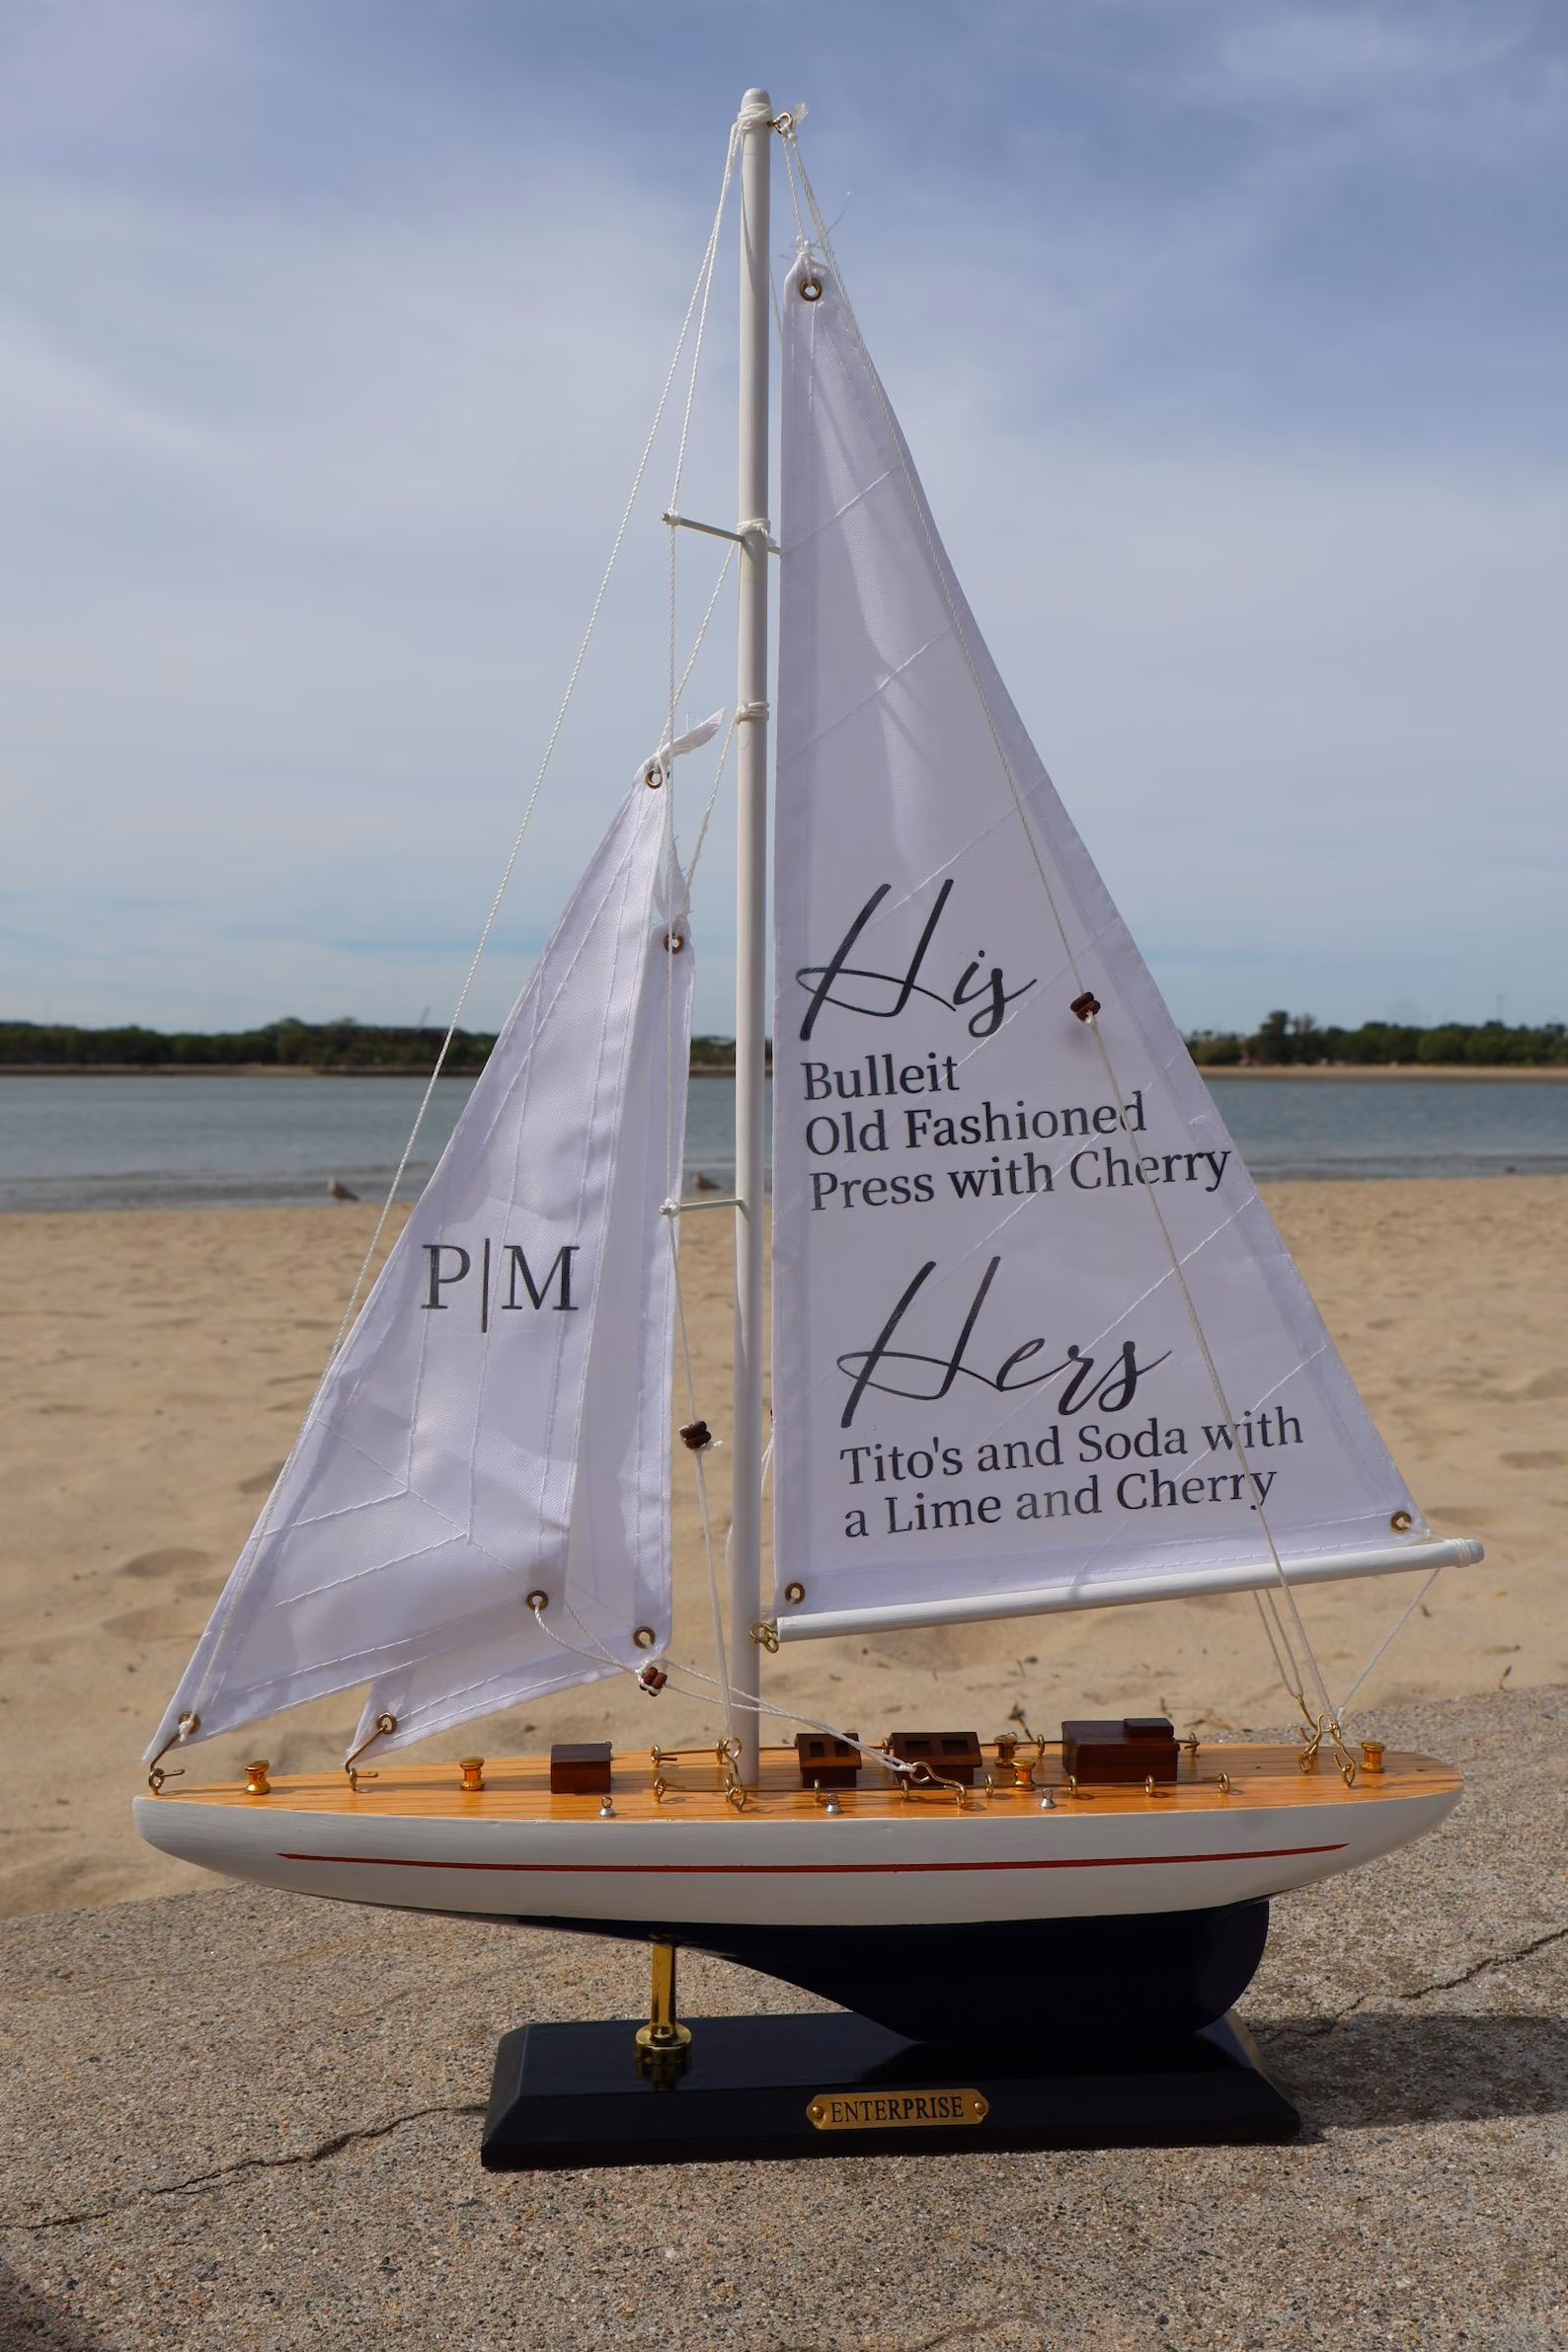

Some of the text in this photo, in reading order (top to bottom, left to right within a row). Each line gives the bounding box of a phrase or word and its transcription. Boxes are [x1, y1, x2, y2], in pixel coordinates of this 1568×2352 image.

[796, 879, 1037, 1041] His
[801, 1052, 960, 1101] Bulleit
[806, 1090, 1147, 1156] Old Fashioned
[810, 1145, 1231, 1212] Press with Cherry
[836, 1256, 1172, 1428] Hers
[840, 1406, 1304, 1485] Tito's and Soda with
[844, 1468, 1278, 1538] a Lime and Cherry
[830, 2096, 964, 2123] ENTERPRISE
